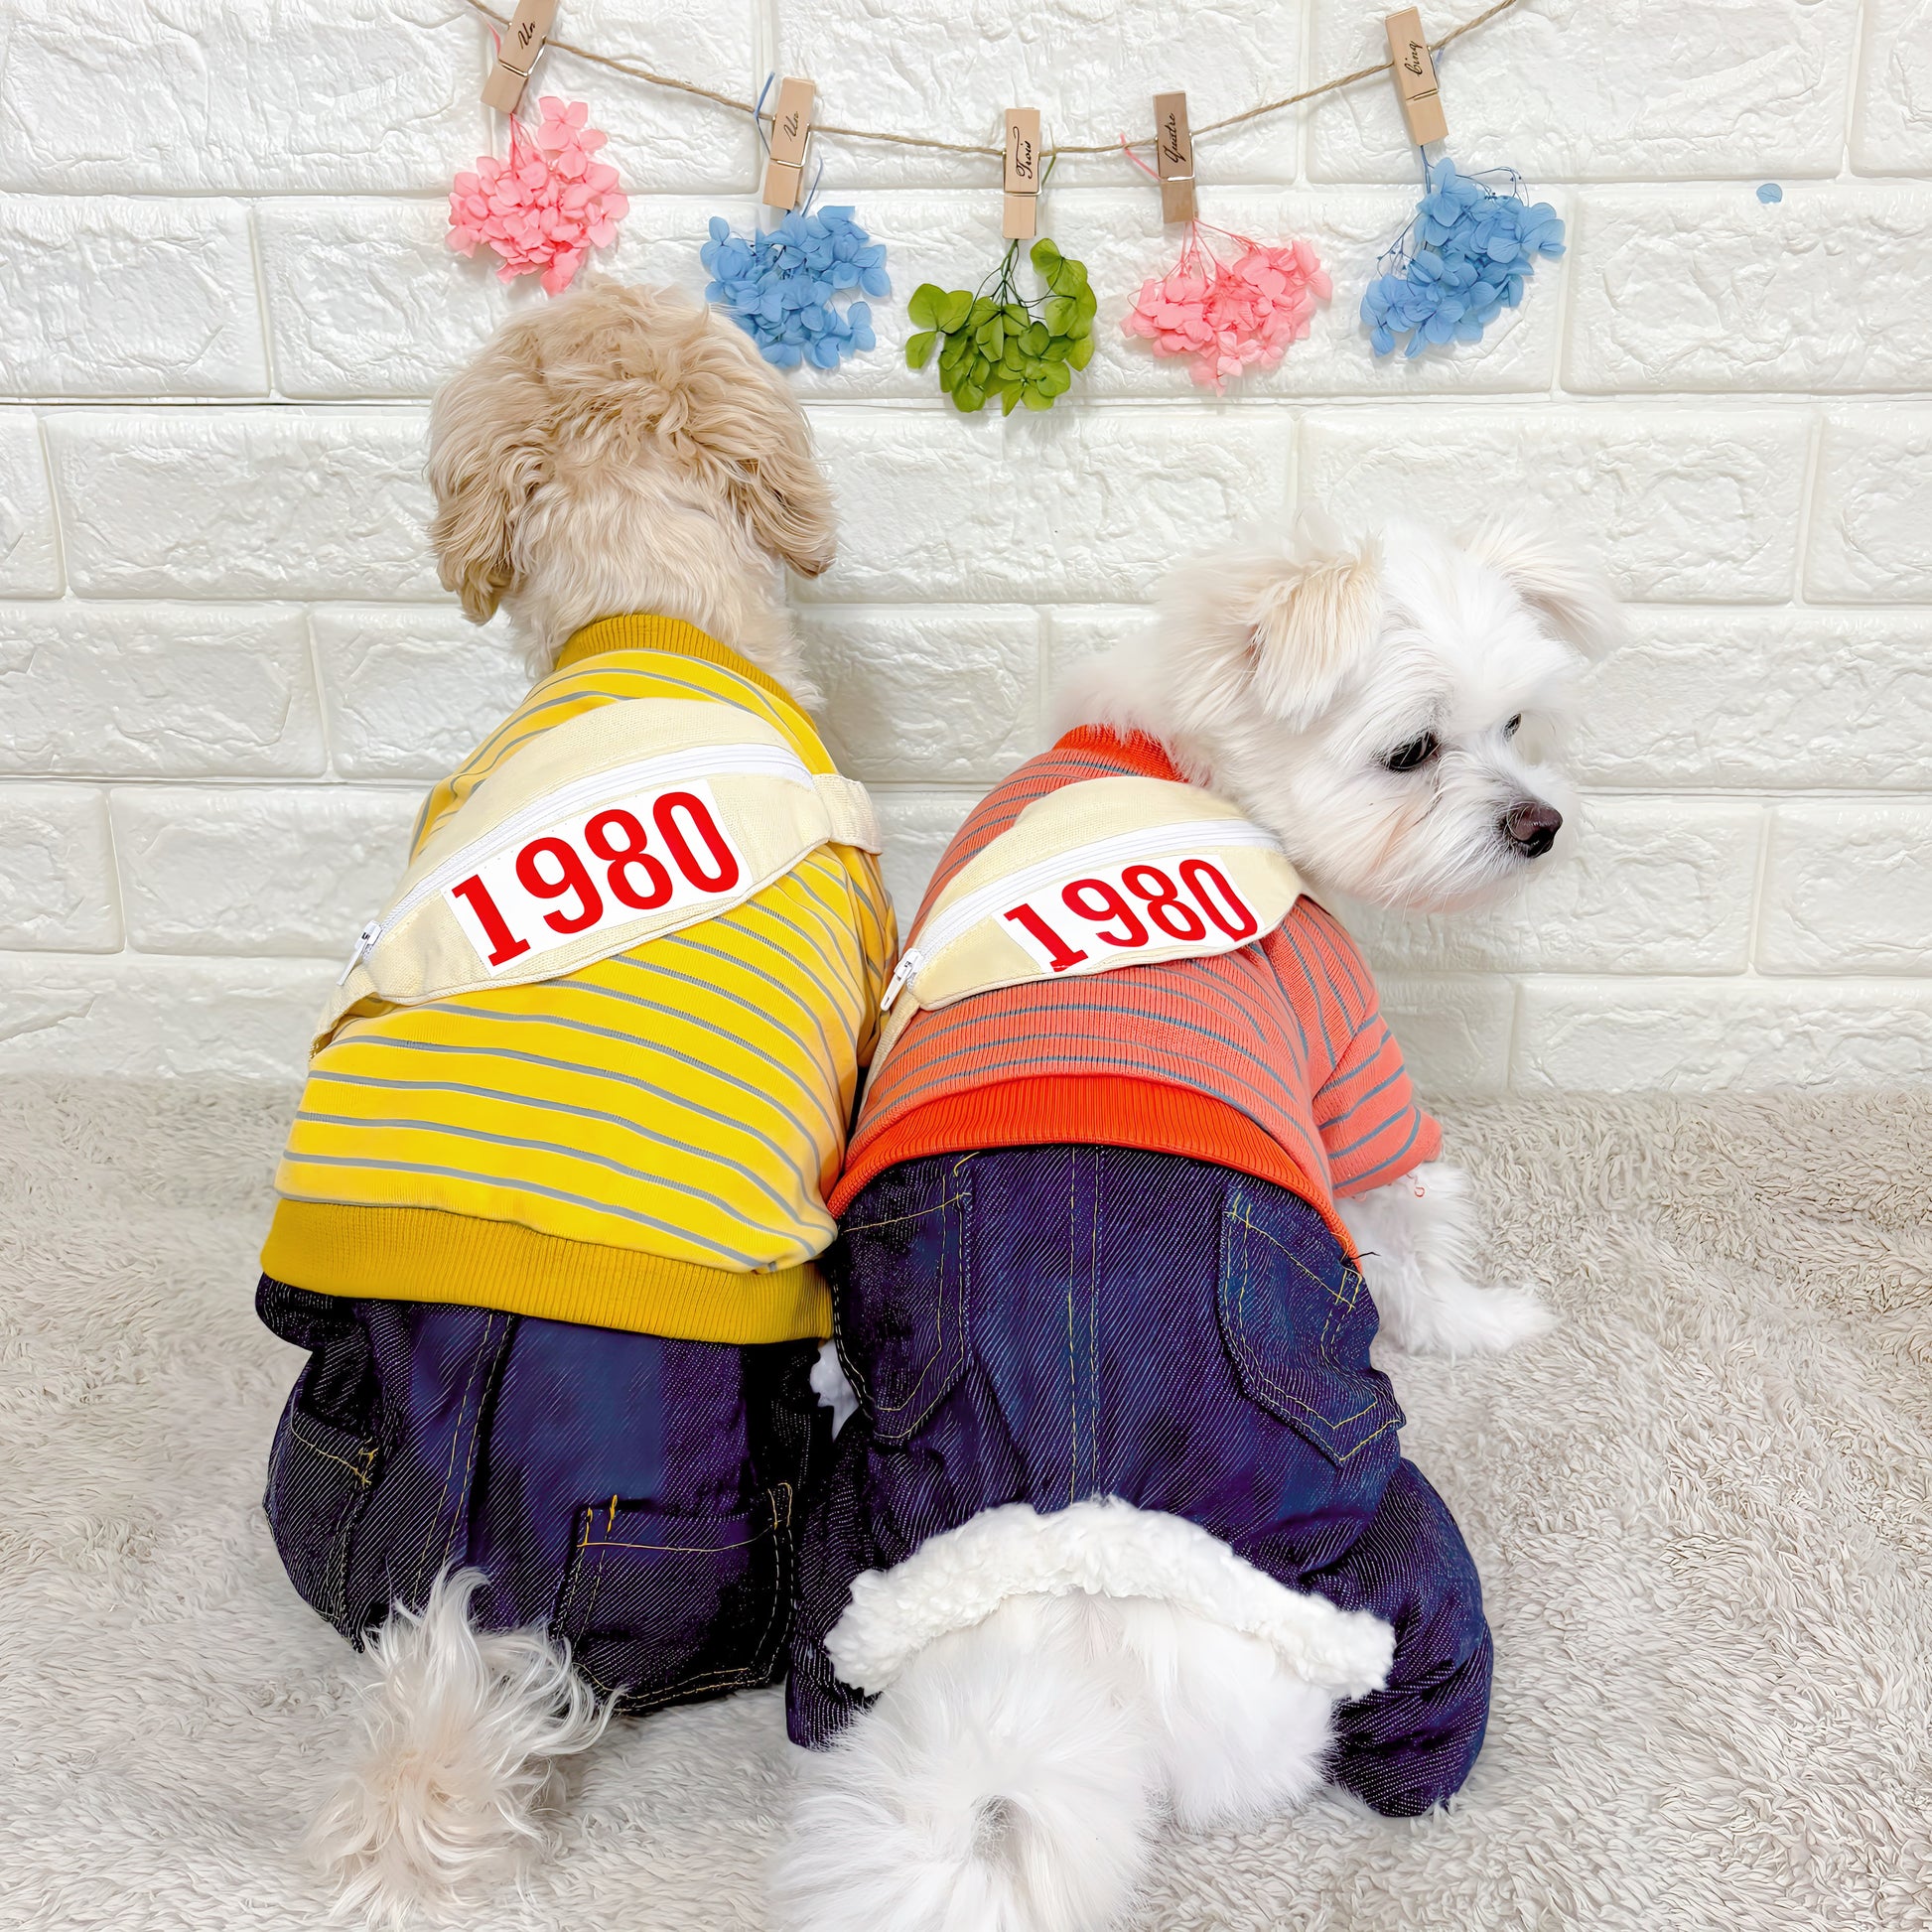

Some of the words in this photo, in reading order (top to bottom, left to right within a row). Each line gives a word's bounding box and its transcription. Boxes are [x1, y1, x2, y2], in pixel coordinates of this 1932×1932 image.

[518, 21, 536, 50] Un
[1404, 41, 1423, 76] Cinq
[1013, 126, 1033, 179] Trois
[451, 791, 740, 967] 1980
[1003, 859, 1258, 973] 1980
